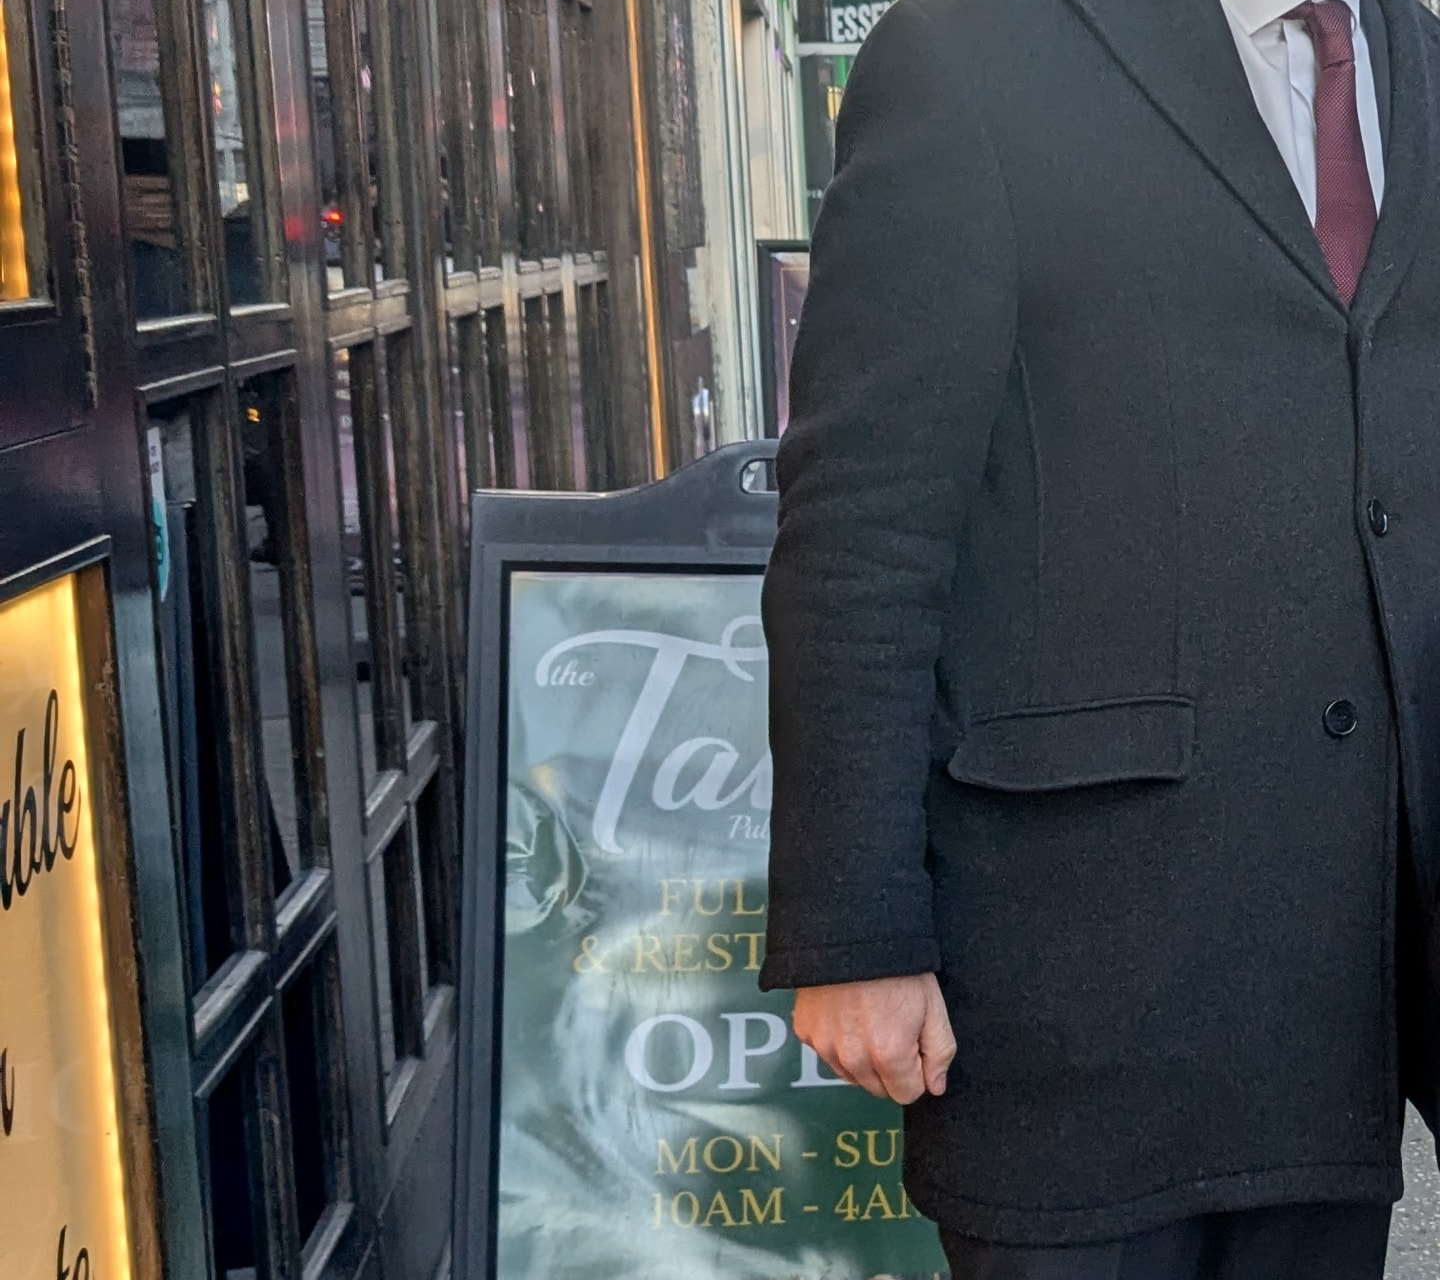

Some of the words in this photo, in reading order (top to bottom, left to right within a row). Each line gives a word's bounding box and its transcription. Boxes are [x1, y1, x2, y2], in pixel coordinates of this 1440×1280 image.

[831, 1, 891, 44] ESSE
[550, 659, 596, 686] the
[659, 878, 768, 917] FUL
[573, 934, 612, 973] &
[634, 931, 767, 972] REST
[655, 1133, 784, 1175] MON
[834, 1129, 900, 1168] SU
[652, 1187, 786, 1229] 10AM
